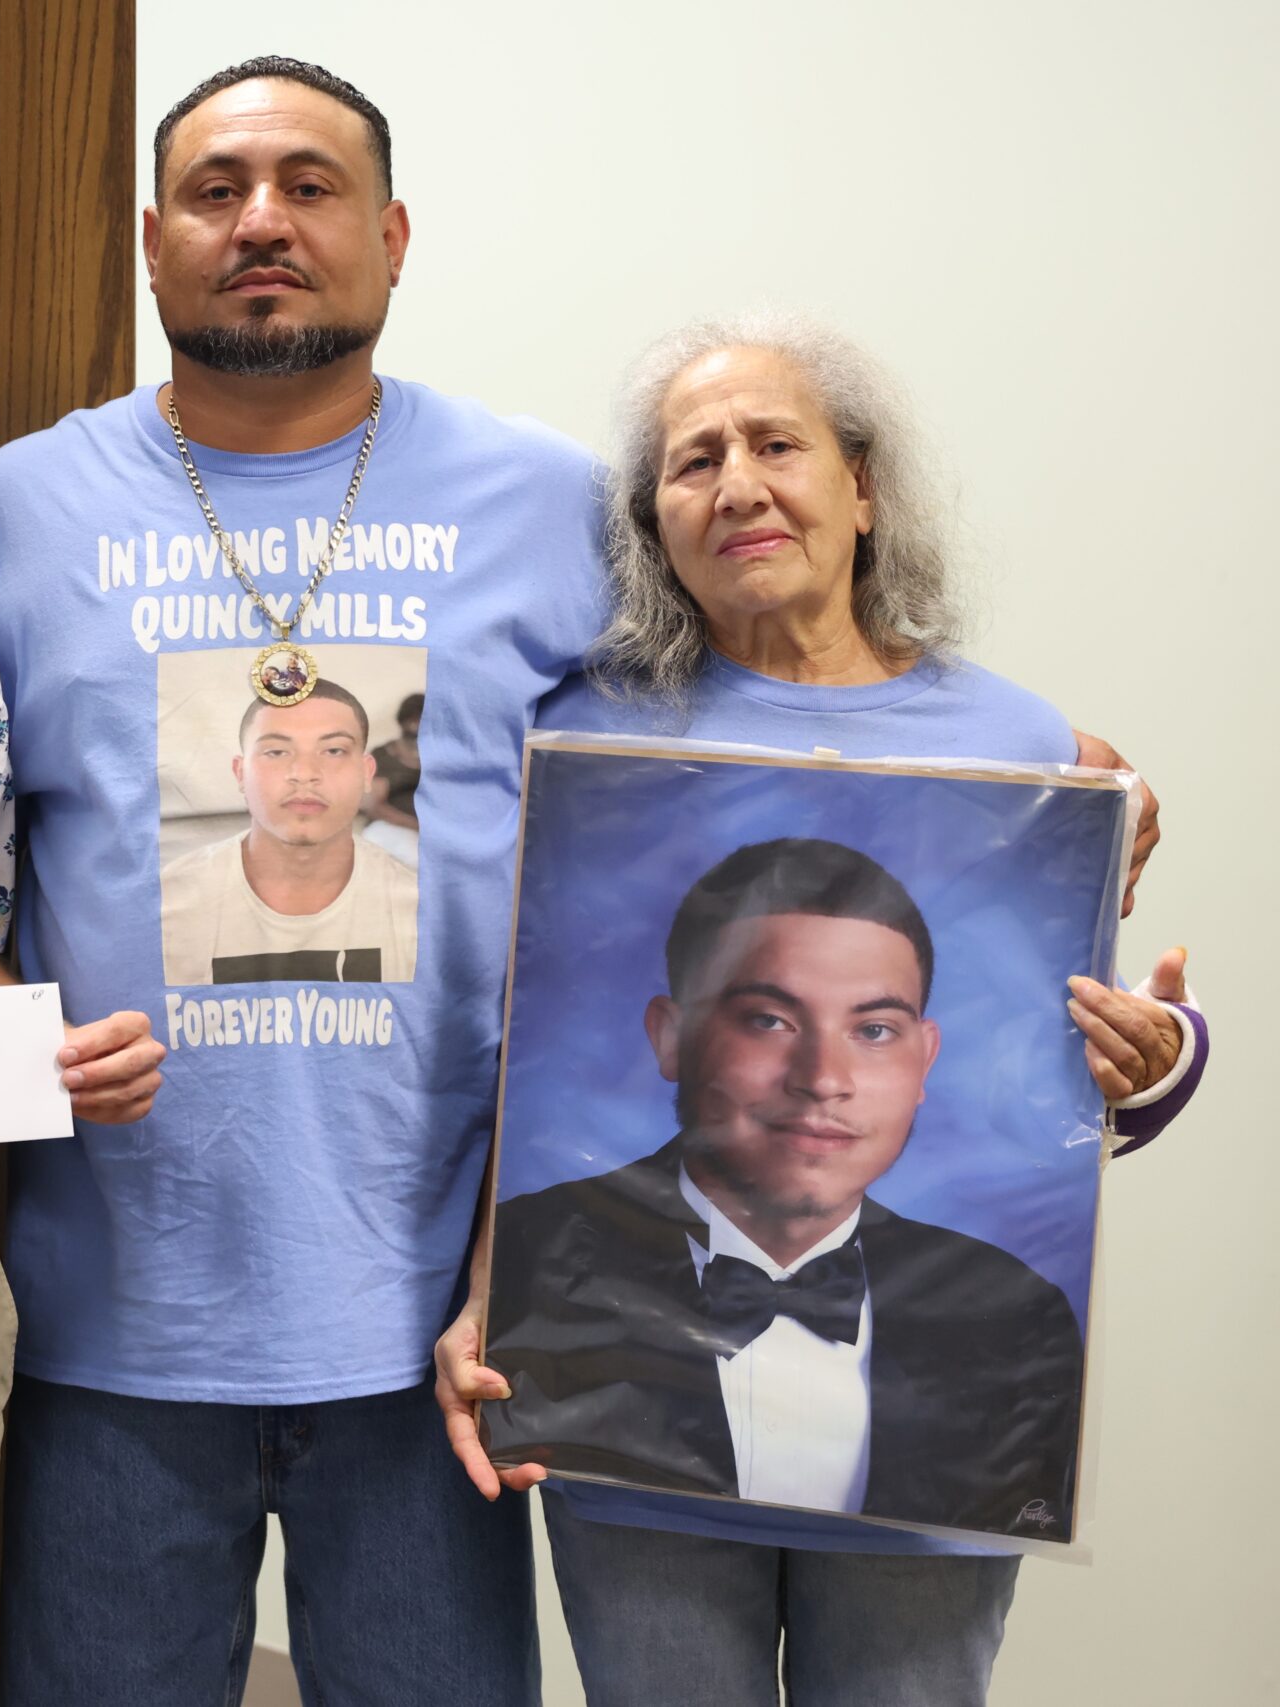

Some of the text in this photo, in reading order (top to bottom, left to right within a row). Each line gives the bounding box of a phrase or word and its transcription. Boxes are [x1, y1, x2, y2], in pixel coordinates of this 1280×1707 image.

[98, 517, 460, 593] IN LOVING MEMORY
[131, 593, 427, 654] QUINCY MILLS
[165, 988, 394, 1050] FOREVER YOUNG
